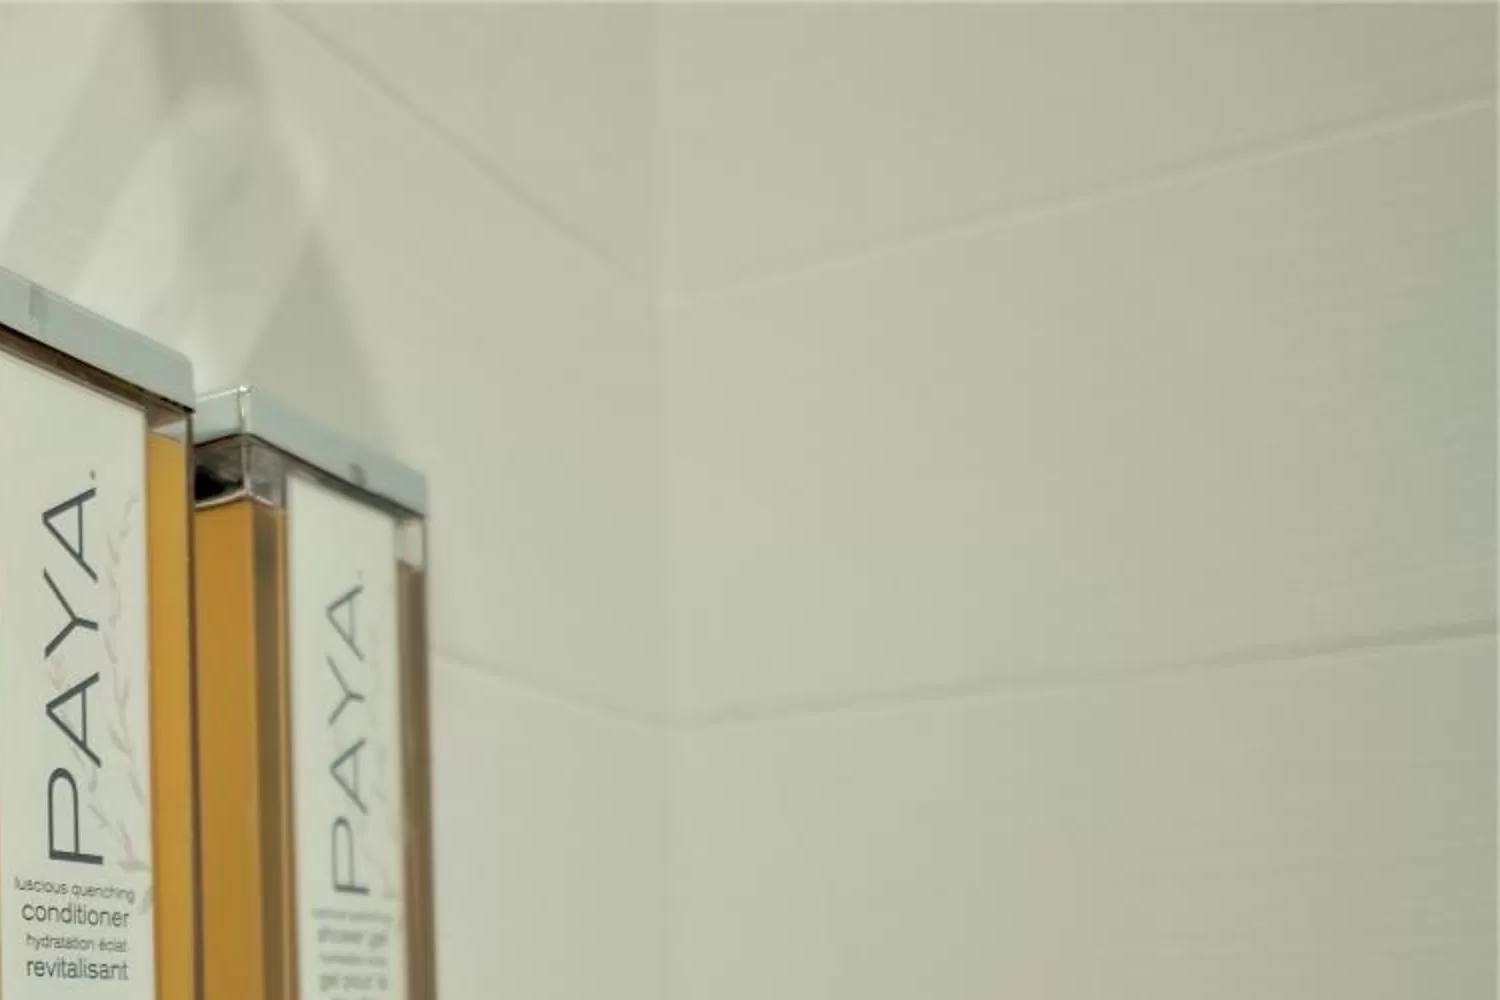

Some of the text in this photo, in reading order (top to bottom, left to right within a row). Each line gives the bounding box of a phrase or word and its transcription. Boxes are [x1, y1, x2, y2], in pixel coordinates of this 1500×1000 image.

[42, 487, 104, 865] PAYA
[13, 876, 135, 905] luscious quenching
[21, 903, 130, 928] conditioner
[26, 956, 129, 981] revitalisant
